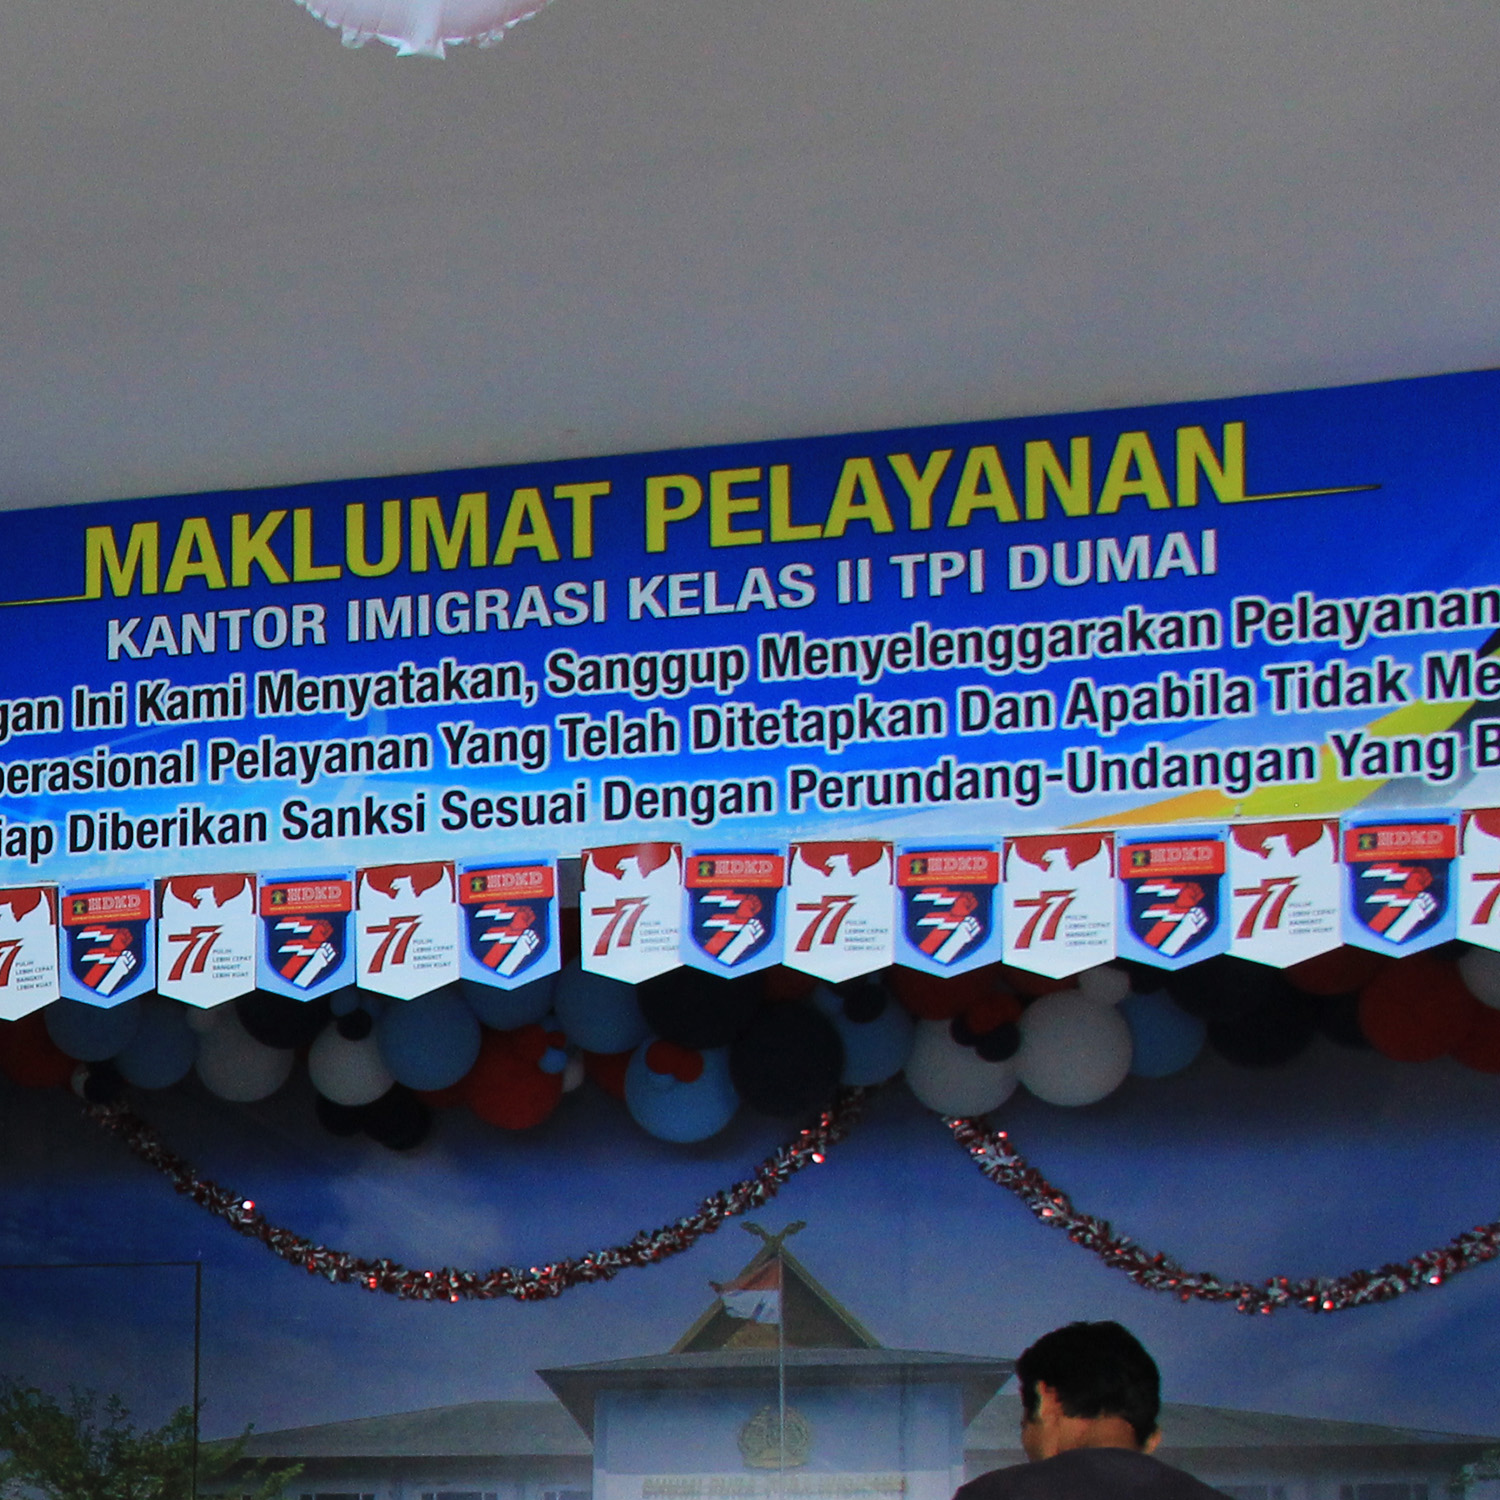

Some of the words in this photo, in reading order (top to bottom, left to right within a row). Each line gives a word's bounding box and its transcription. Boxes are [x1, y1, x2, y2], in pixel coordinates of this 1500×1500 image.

[85, 480, 611, 599] MAKLUMAT
[645, 421, 1246, 552] PELAYANAN
[107, 603, 327, 661] KANTOR
[347, 580, 606, 643] IMIGRASI
[628, 562, 817, 620] KELAS
[837, 558, 871, 604] II
[890, 548, 984, 598] TPI
[1008, 529, 1217, 591] DUMAI
[75, 685, 123, 728] Ini
[140, 677, 242, 724] Kami
[258, 661, 535, 716] Menyatakan,
[549, 649, 744, 697] Sanggup
[761, 608, 1217, 682] Menyelenggarakan
[1236, 589, 1500, 646] Pelayanan
[210, 737, 429, 785] Pelayanan
[443, 725, 546, 770] Yang
[560, 712, 675, 758] Telah
[693, 699, 942, 750] Ditetapkan
[961, 691, 1050, 733] Dan
[1066, 672, 1250, 732] Apabila
[1266, 660, 1408, 711] Tidak
[1426, 653, 1500, 700] Me
[69, 808, 267, 854] Diberikan
[282, 794, 426, 840] Sanksi
[442, 783, 587, 831] Sesuai
[604, 779, 773, 825] Dengan
[789, 745, 1315, 811] Perundang-Undangan
[1330, 732, 1455, 781] Yang
[88, 894, 140, 911] HDKD
[287, 886, 342, 901] HDKD
[487, 871, 543, 888] HDKD
[1234, 875, 1300, 939] 77
[367, 914, 422, 973] 77
[591, 896, 651, 956] 77
[795, 895, 858, 951] 77
[1014, 889, 1077, 949] 77
[168, 925, 223, 981] 77
